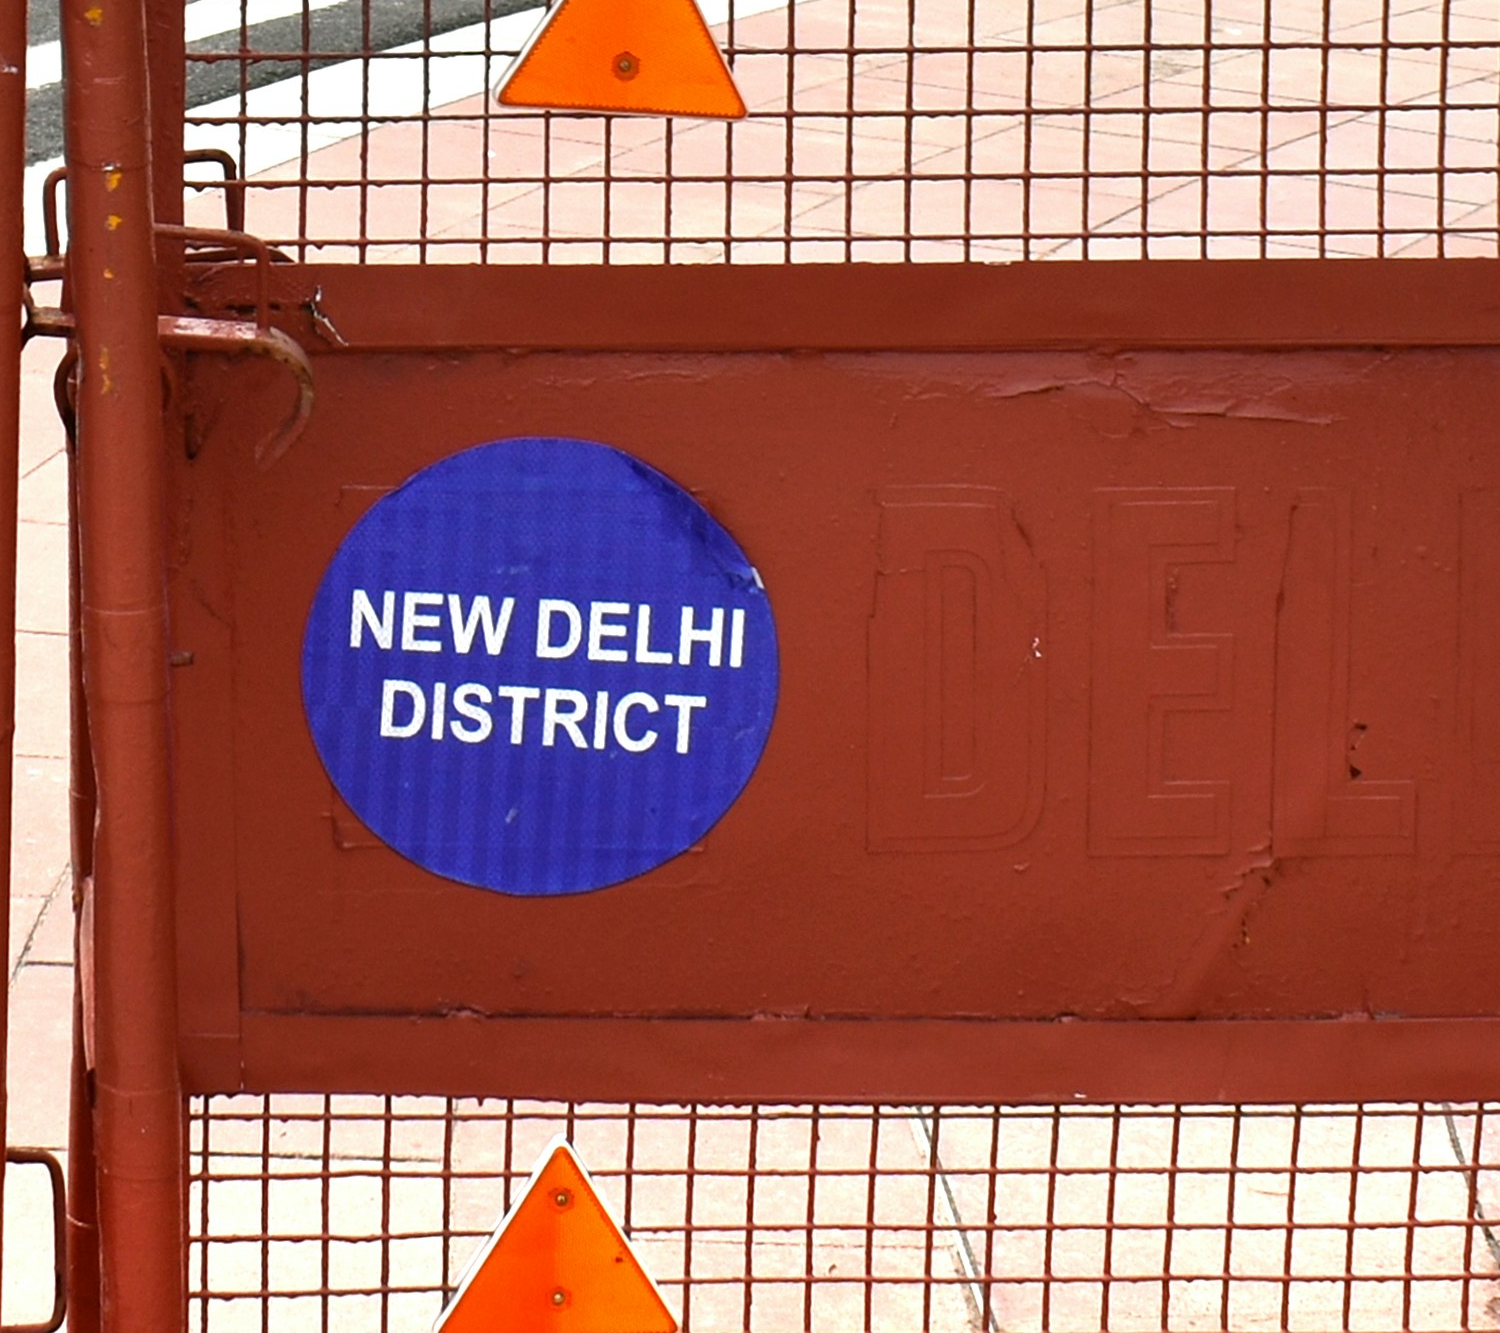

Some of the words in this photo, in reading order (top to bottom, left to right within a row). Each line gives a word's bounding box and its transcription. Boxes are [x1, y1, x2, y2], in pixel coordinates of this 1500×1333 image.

[349, 589, 516, 657] NEW
[536, 598, 746, 669] DELHI
[378, 678, 707, 755] DISTRICT
